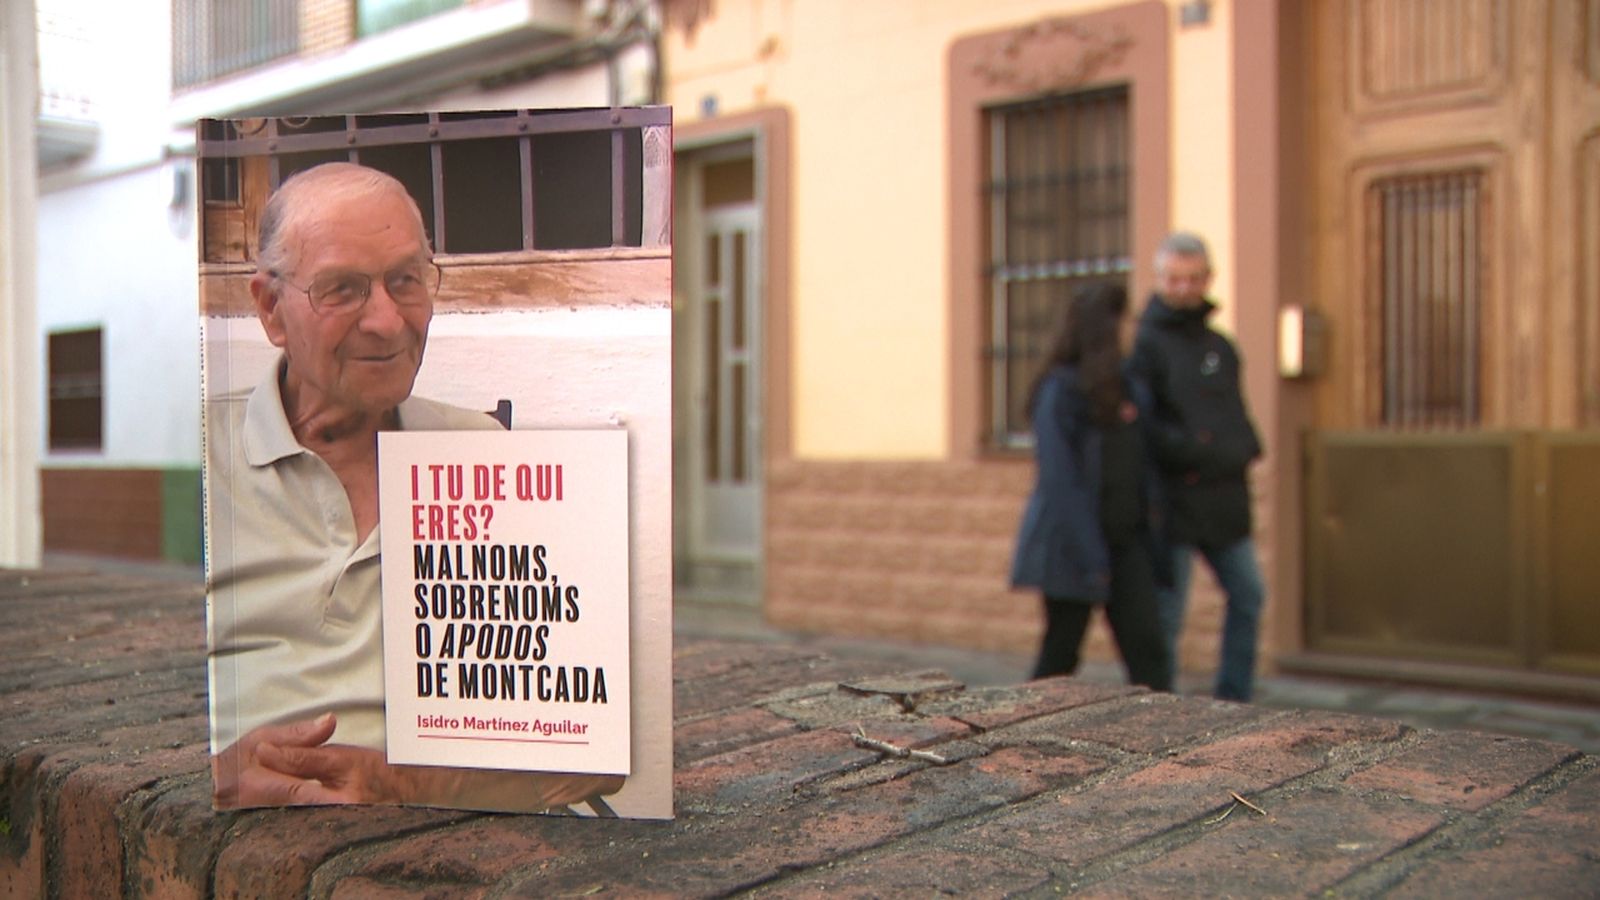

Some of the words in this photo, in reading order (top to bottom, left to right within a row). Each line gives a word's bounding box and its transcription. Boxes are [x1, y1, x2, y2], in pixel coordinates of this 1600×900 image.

[411, 464, 419, 501] I
[428, 464, 464, 501] TU
[473, 464, 507, 501] DE
[515, 463, 563, 501] QUI
[412, 504, 494, 541] ERES?
[413, 544, 558, 586] MALNOMS,
[414, 583, 580, 623] SOBRENOMS
[415, 623, 431, 659] O
[439, 623, 550, 661] APODOS
[416, 662, 449, 698] DE
[458, 663, 608, 704] MONTCADA
[416, 714, 460, 731] Isidro
[463, 716, 529, 733] Martínez
[532, 718, 589, 737] Aguilar
